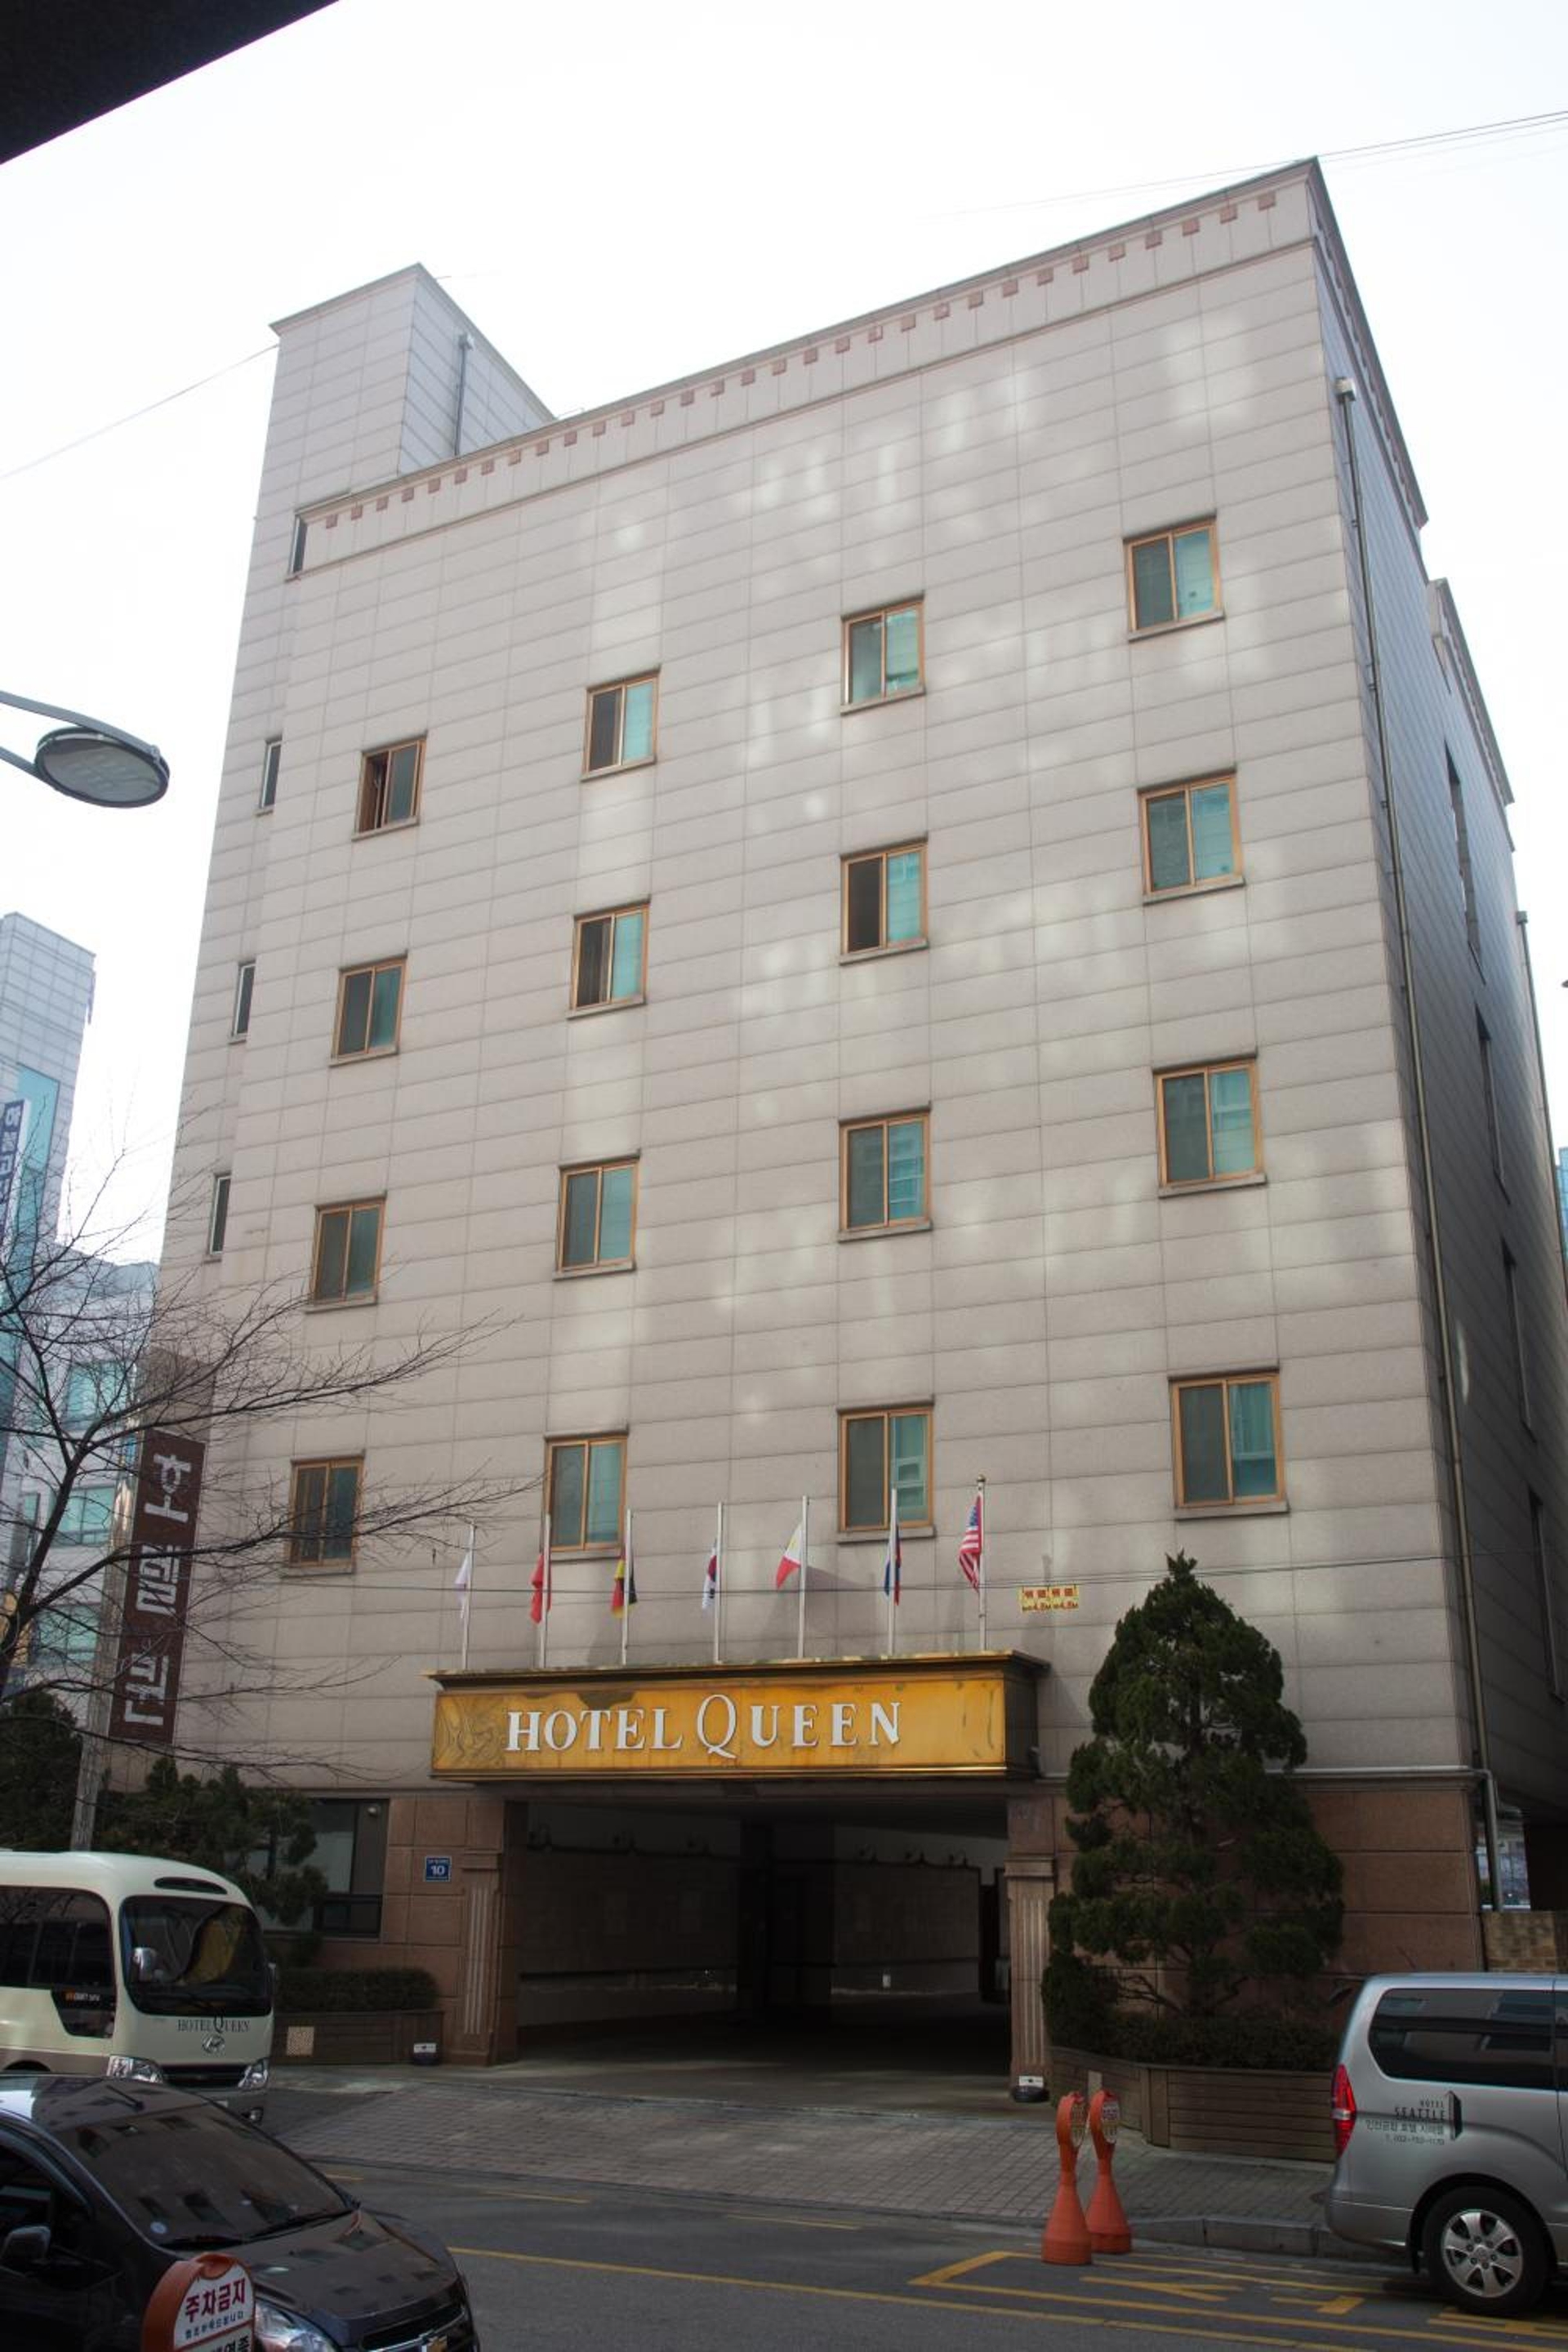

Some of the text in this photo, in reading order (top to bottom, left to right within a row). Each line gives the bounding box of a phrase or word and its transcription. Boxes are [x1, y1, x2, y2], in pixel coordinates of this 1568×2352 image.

[122, 1452, 192, 1726] 호텔퀸
[505, 1693, 902, 1759] HOTEL QUEEN
[430, 1865, 446, 1877] 10
[177, 2019, 212, 2033] HOTEL
[1393, 2106, 1446, 2122] SEATTLE
[185, 2278, 246, 2323] 주차금지
